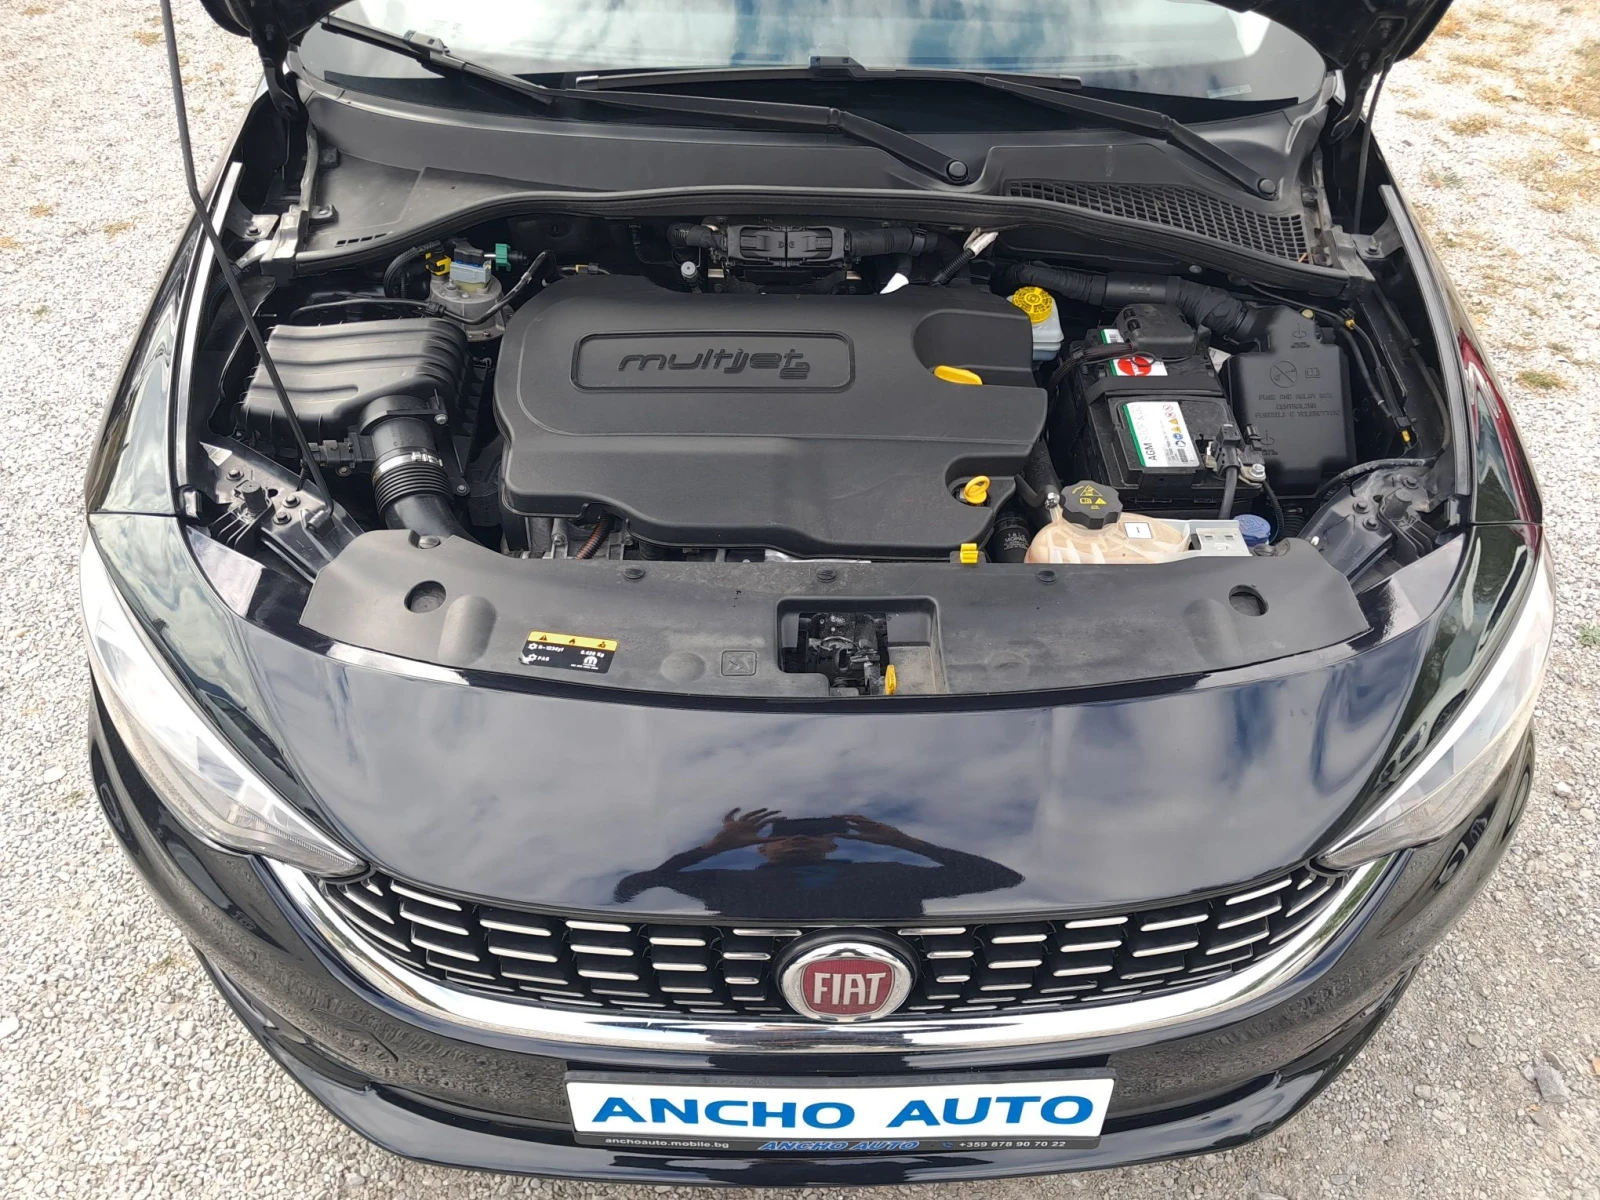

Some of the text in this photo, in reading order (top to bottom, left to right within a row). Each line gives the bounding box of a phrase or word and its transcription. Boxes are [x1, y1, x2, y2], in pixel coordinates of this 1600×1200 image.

[813, 972, 887, 1006] FIAT
[591, 1095, 1094, 1129] ANCHO AUTO
[605, 1138, 730, 1149] anchoauto.mobile.bg
[758, 1140, 920, 1151] ANCHO AUTO
[959, 1140, 987, 1148] +359
[991, 1140, 1013, 1148] 878
[1015, 1140, 1031, 1148] 90
[1034, 1140, 1048, 1148] 70
